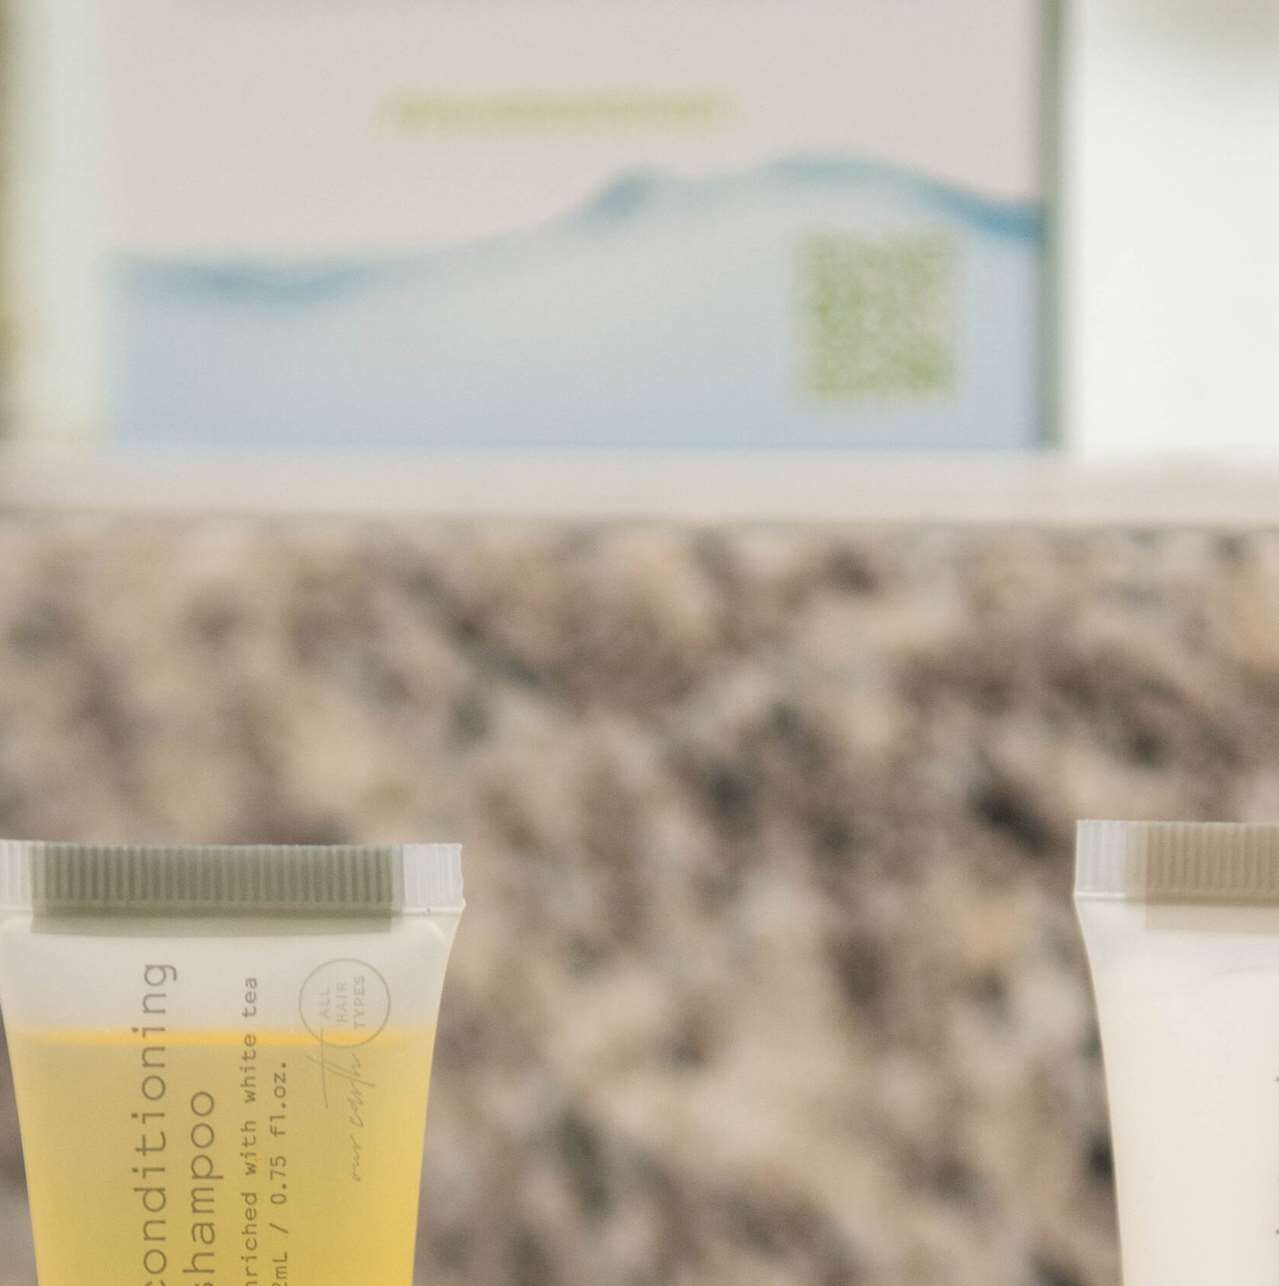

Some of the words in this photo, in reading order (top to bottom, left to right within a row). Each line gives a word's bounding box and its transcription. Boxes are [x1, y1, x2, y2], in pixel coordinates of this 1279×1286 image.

[241, 977, 257, 1017] tea
[319, 986, 331, 1018] ALL
[336, 981, 348, 1023] HAIR
[353, 975, 366, 1030] TYPES
[241, 1033, 257, 1103] white
[269, 1061, 287, 1138] fl.oz.
[241, 1120, 257, 1176] with
[270, 1155, 287, 1205] 0.75
[270, 1222, 288, 1234] /
